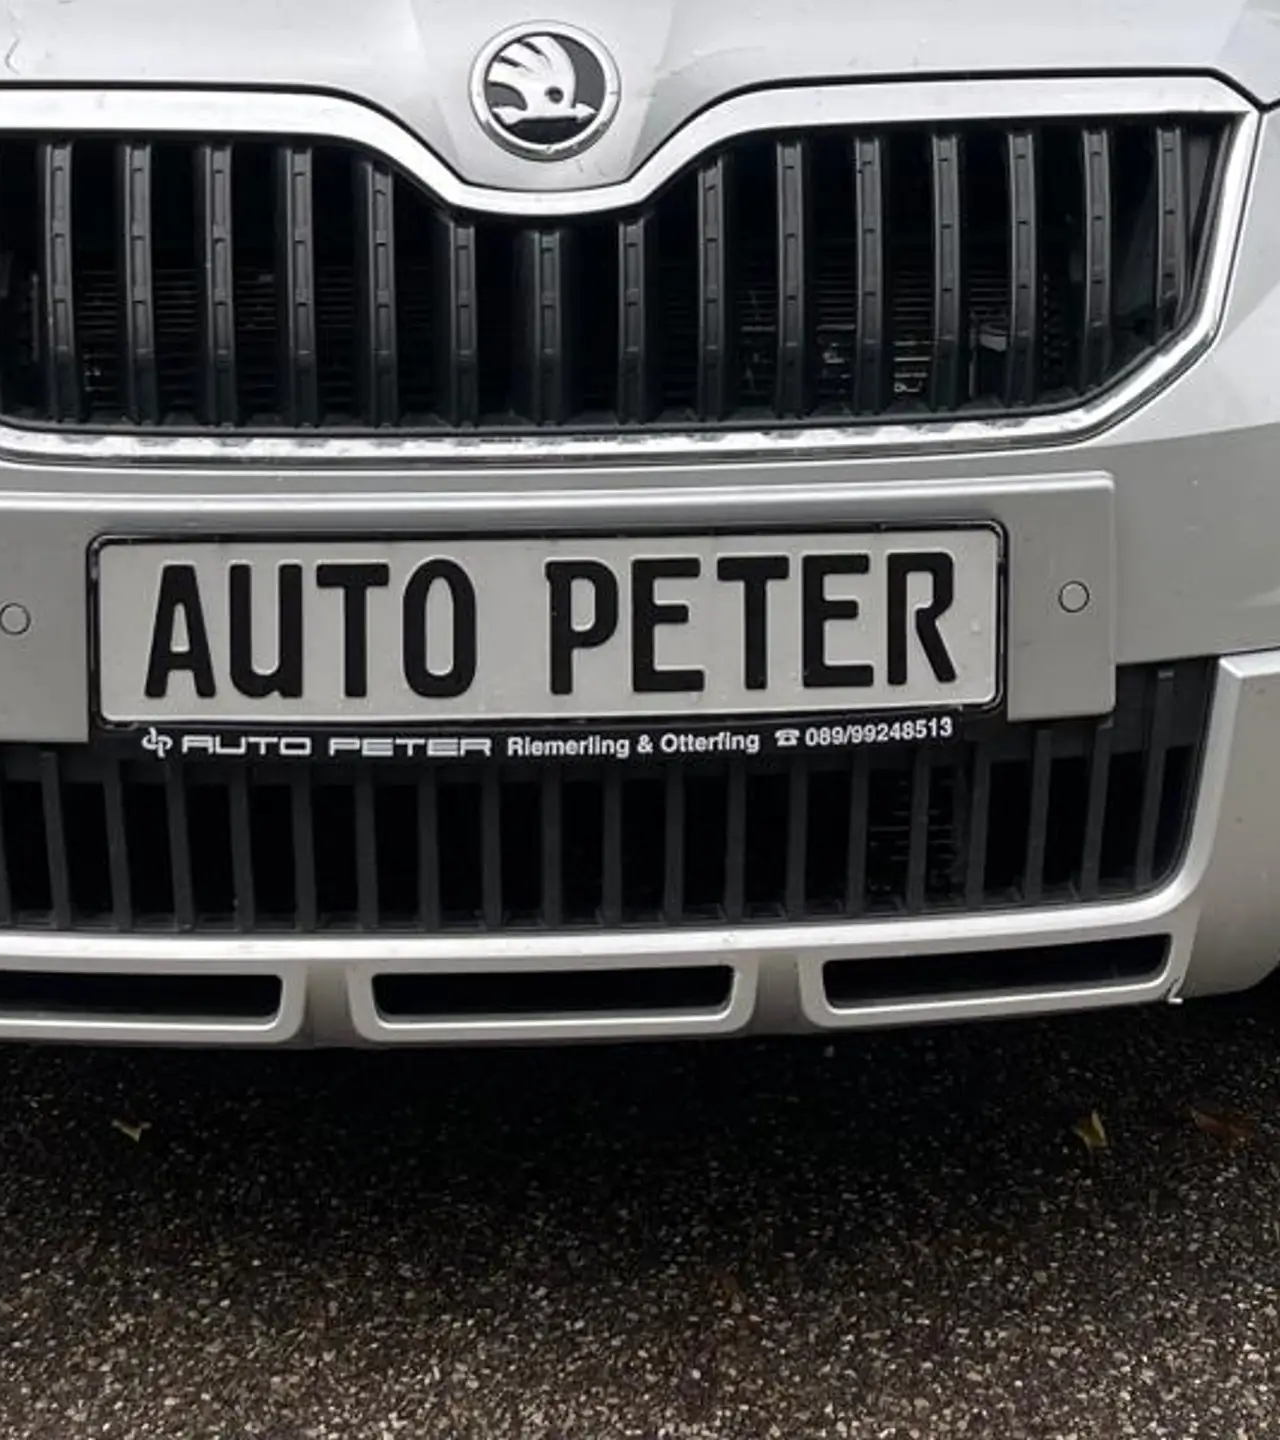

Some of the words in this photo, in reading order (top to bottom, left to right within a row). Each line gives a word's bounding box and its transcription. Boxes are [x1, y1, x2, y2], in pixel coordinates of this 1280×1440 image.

[143, 558, 477, 699] AUTO
[544, 550, 957, 695] PETER
[181, 735, 311, 756] AUTO
[328, 737, 491, 757] PETER
[507, 736, 630, 758] Riemerling
[637, 733, 653, 754] &
[660, 730, 761, 754] Otterfing
[805, 716, 953, 747] 089/99248513
